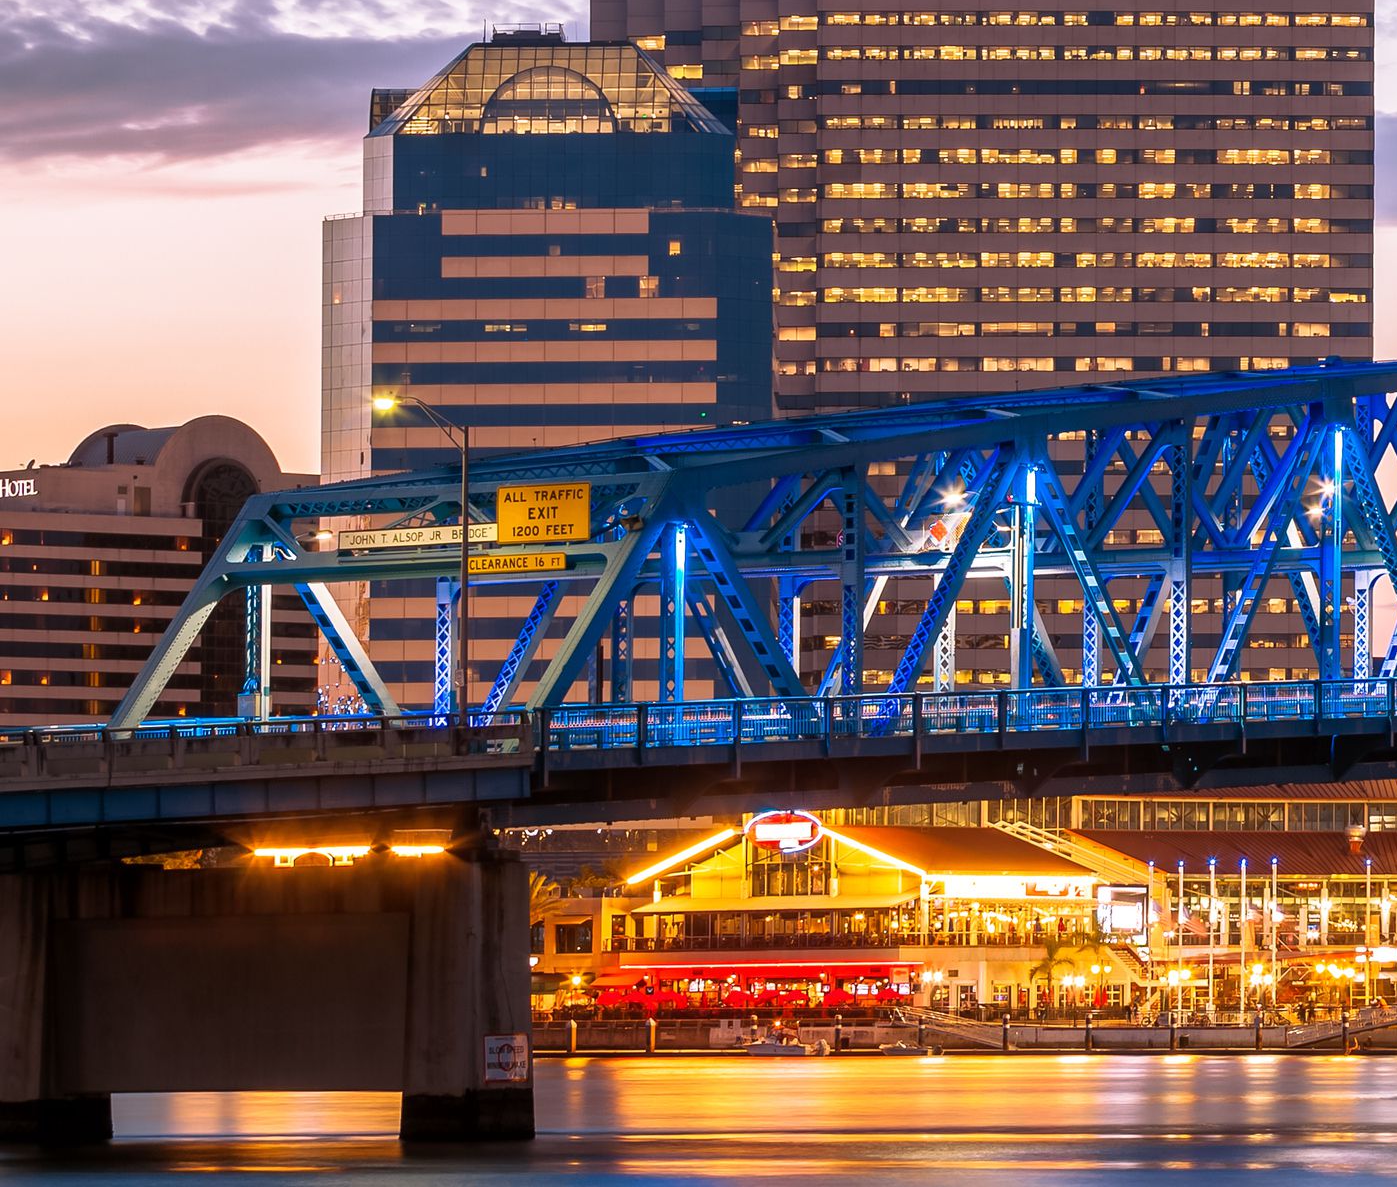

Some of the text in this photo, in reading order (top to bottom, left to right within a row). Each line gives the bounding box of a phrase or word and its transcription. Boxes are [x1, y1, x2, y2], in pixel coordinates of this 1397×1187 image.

[504, 488, 584, 503] ALL TRAFFIC
[528, 506, 559, 520] EXIT
[512, 523, 574, 537] 1200 FEET
[469, 556, 561, 571] CLEARANCE 16 FT
